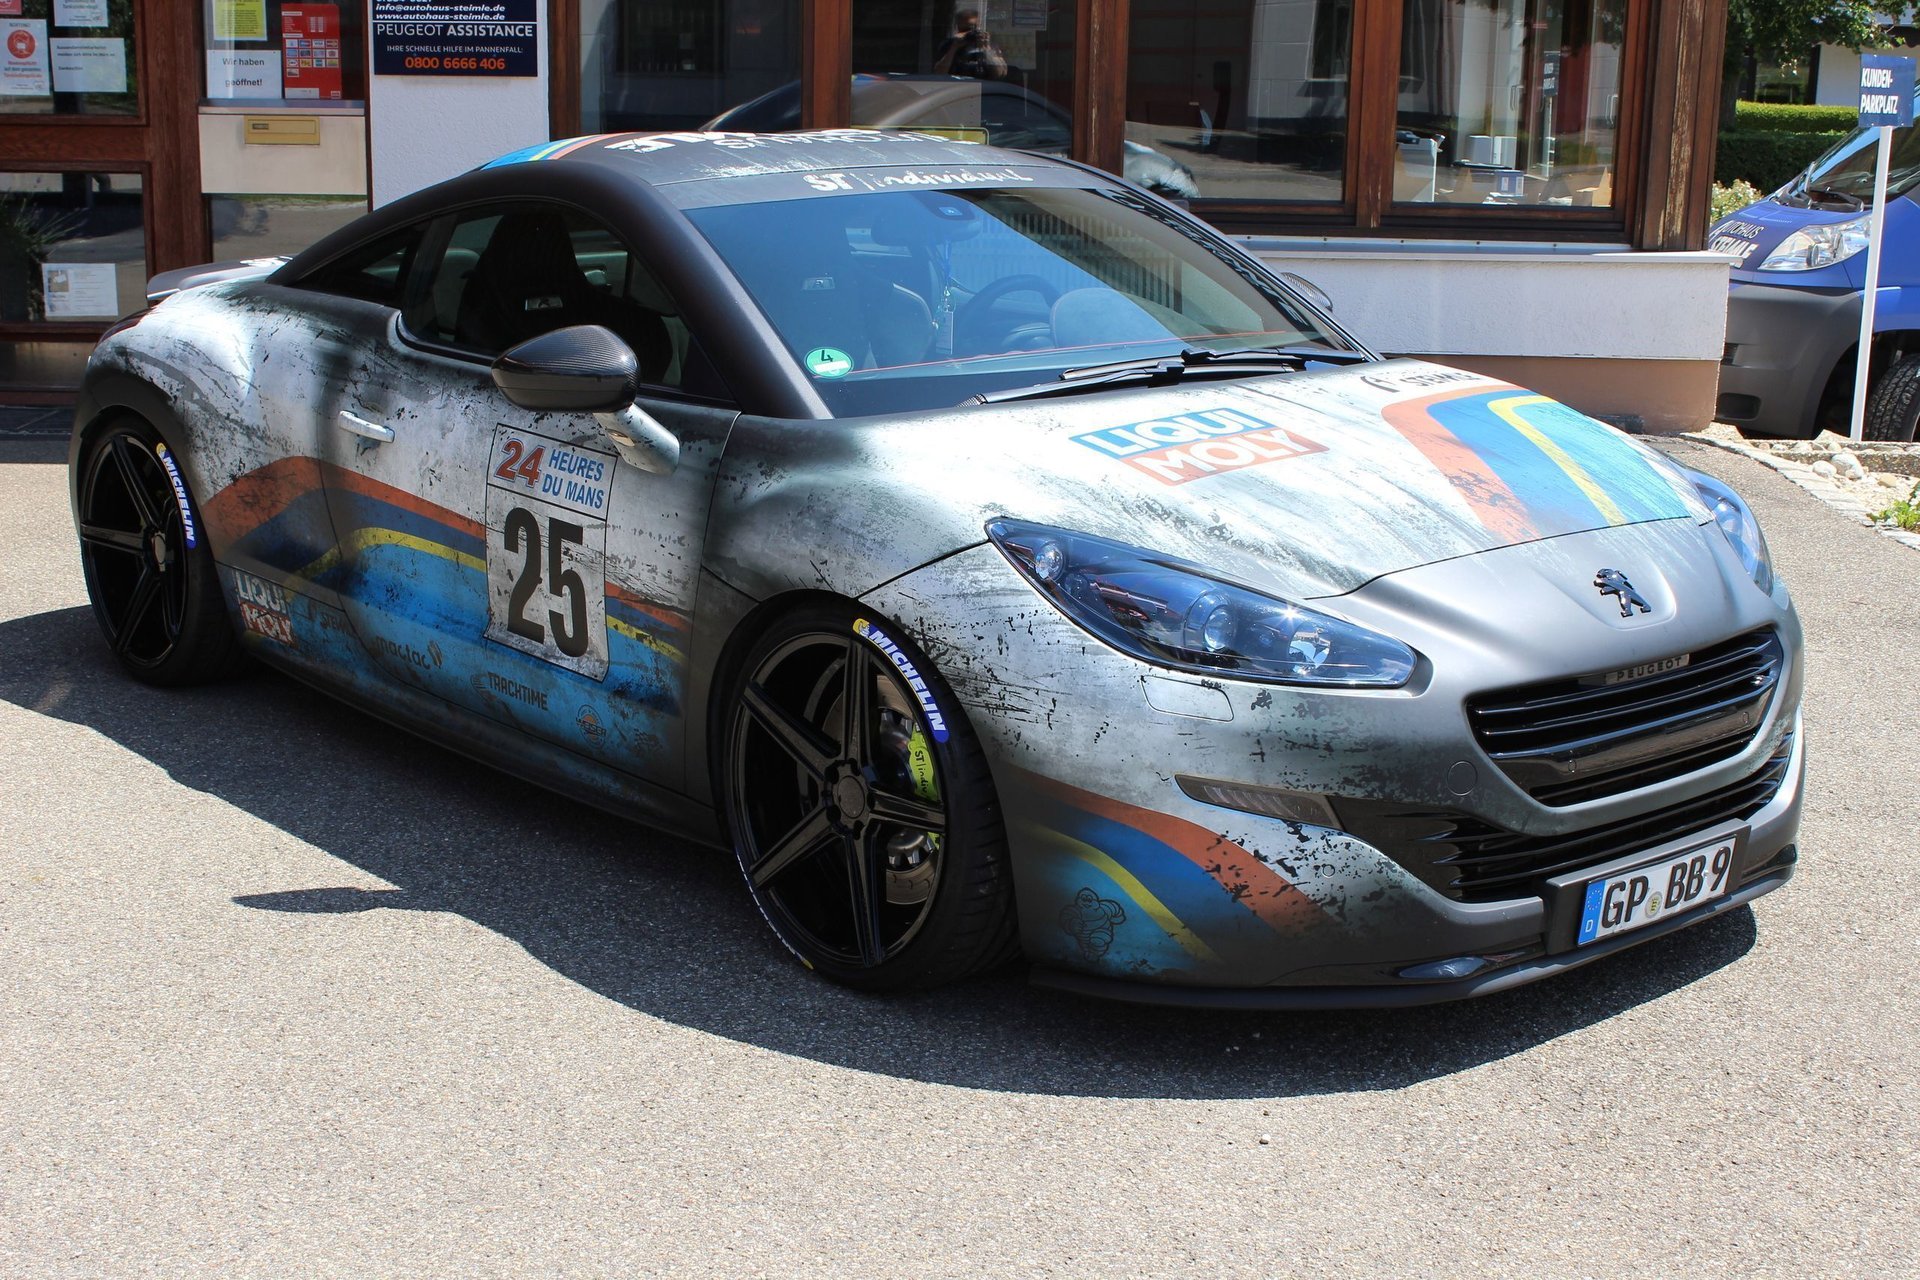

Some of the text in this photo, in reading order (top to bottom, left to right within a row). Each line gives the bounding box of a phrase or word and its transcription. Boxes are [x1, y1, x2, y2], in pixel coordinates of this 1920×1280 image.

[375, 4, 506, 13] info@autohaus-steimle.de
[375, 13, 506, 21] www.autohaus-steimle.de
[377, 24, 533, 37] PEUGEOT ASSISTANCE
[405, 45, 442, 53] SCHNELLE
[475, 46, 523, 54] PANNENFALL:
[222, 58, 265, 66] Wir haben
[405, 57, 506, 70] 0800 6666 406
[225, 78, 262, 88] geöffnet!
[1860, 68, 1893, 89] KUNDEN-
[1859, 94, 1898, 114] PARKPLATZ
[802, 172, 854, 192] ST
[1709, 220, 1765, 243] AUTOHAUS
[820, 349, 834, 362] 4
[1079, 409, 1266, 456] LIQUI
[493, 437, 605, 489] 24 HEURES
[1133, 428, 1310, 482] MOLY
[163, 456, 195, 541] MICHELIN
[541, 473, 605, 510] DU MANS
[235, 570, 288, 615] LIQUI
[503, 507, 589, 658] 25
[242, 603, 293, 641] MOLY
[375, 635, 431, 670] mactac
[868, 630, 947, 731] MICHELIN
[1616, 657, 1684, 682] PEUGEOT
[1601, 846, 1731, 929] GP BB 9
[1585, 919, 1593, 933] D
